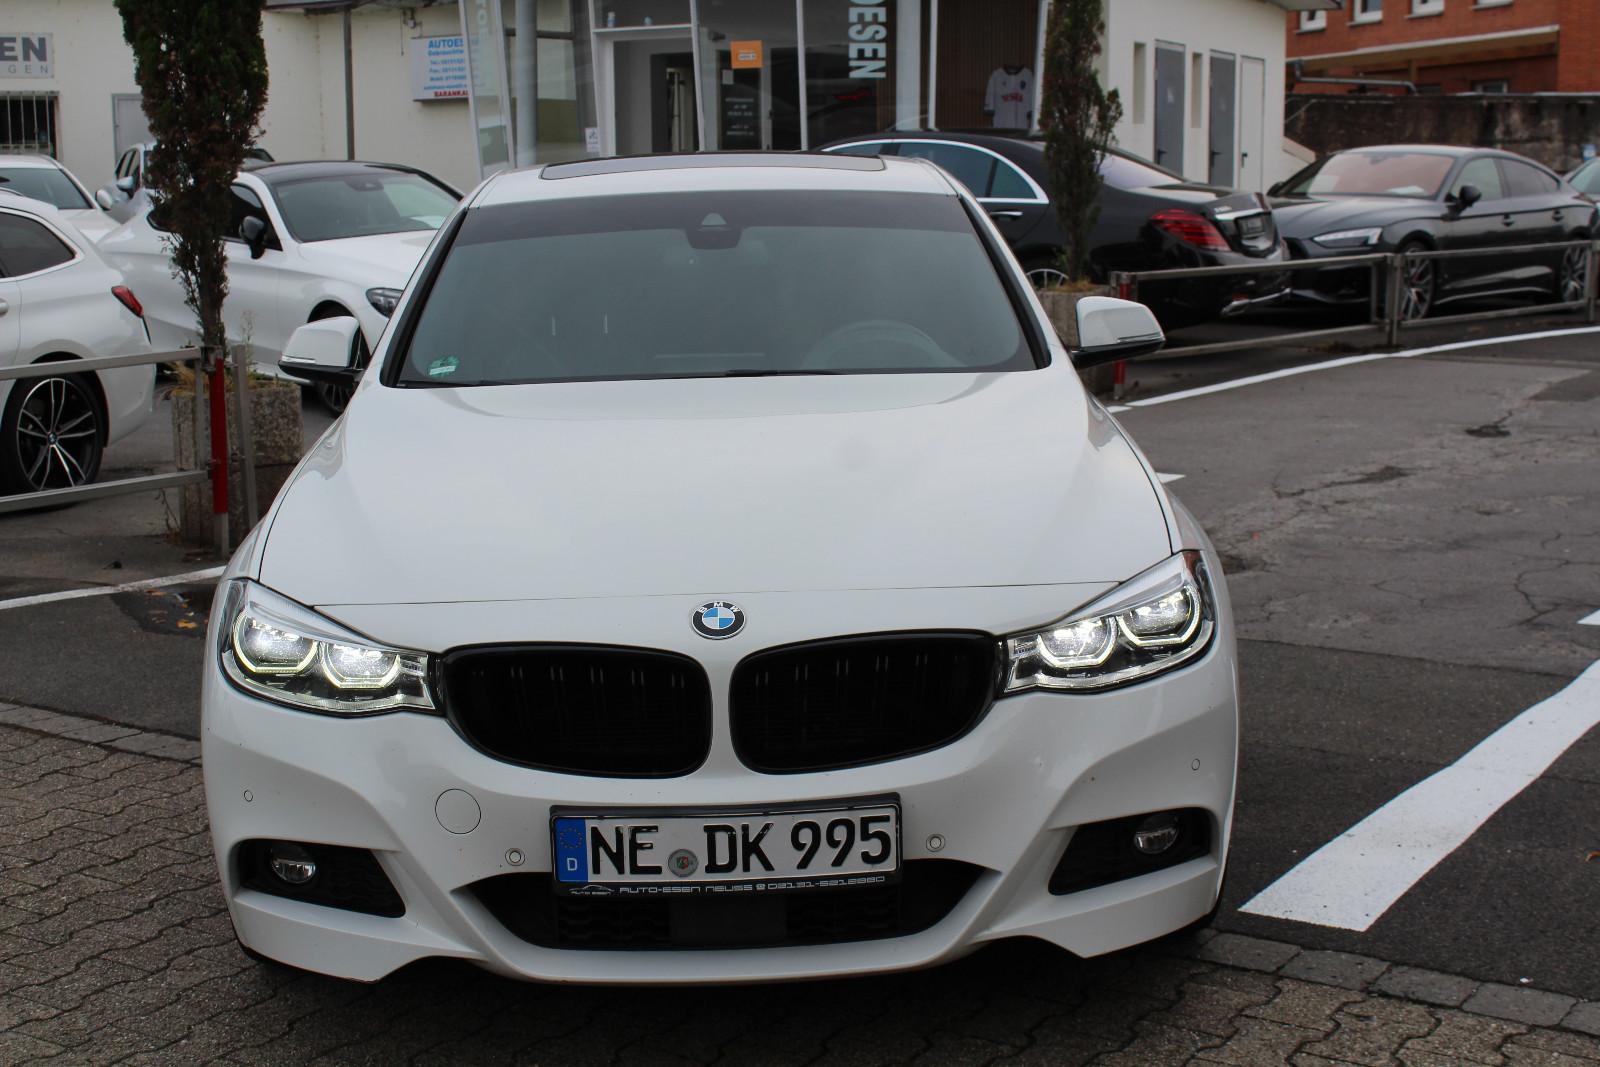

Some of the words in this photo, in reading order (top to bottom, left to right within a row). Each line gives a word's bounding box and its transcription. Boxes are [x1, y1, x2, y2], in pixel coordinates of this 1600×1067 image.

[848, 0, 887, 78] ESEN
[697, 601, 741, 614] BMW
[590, 825, 663, 875] NE
[703, 822, 775, 874] DK
[790, 815, 892, 870] 995
[566, 857, 578, 871] D
